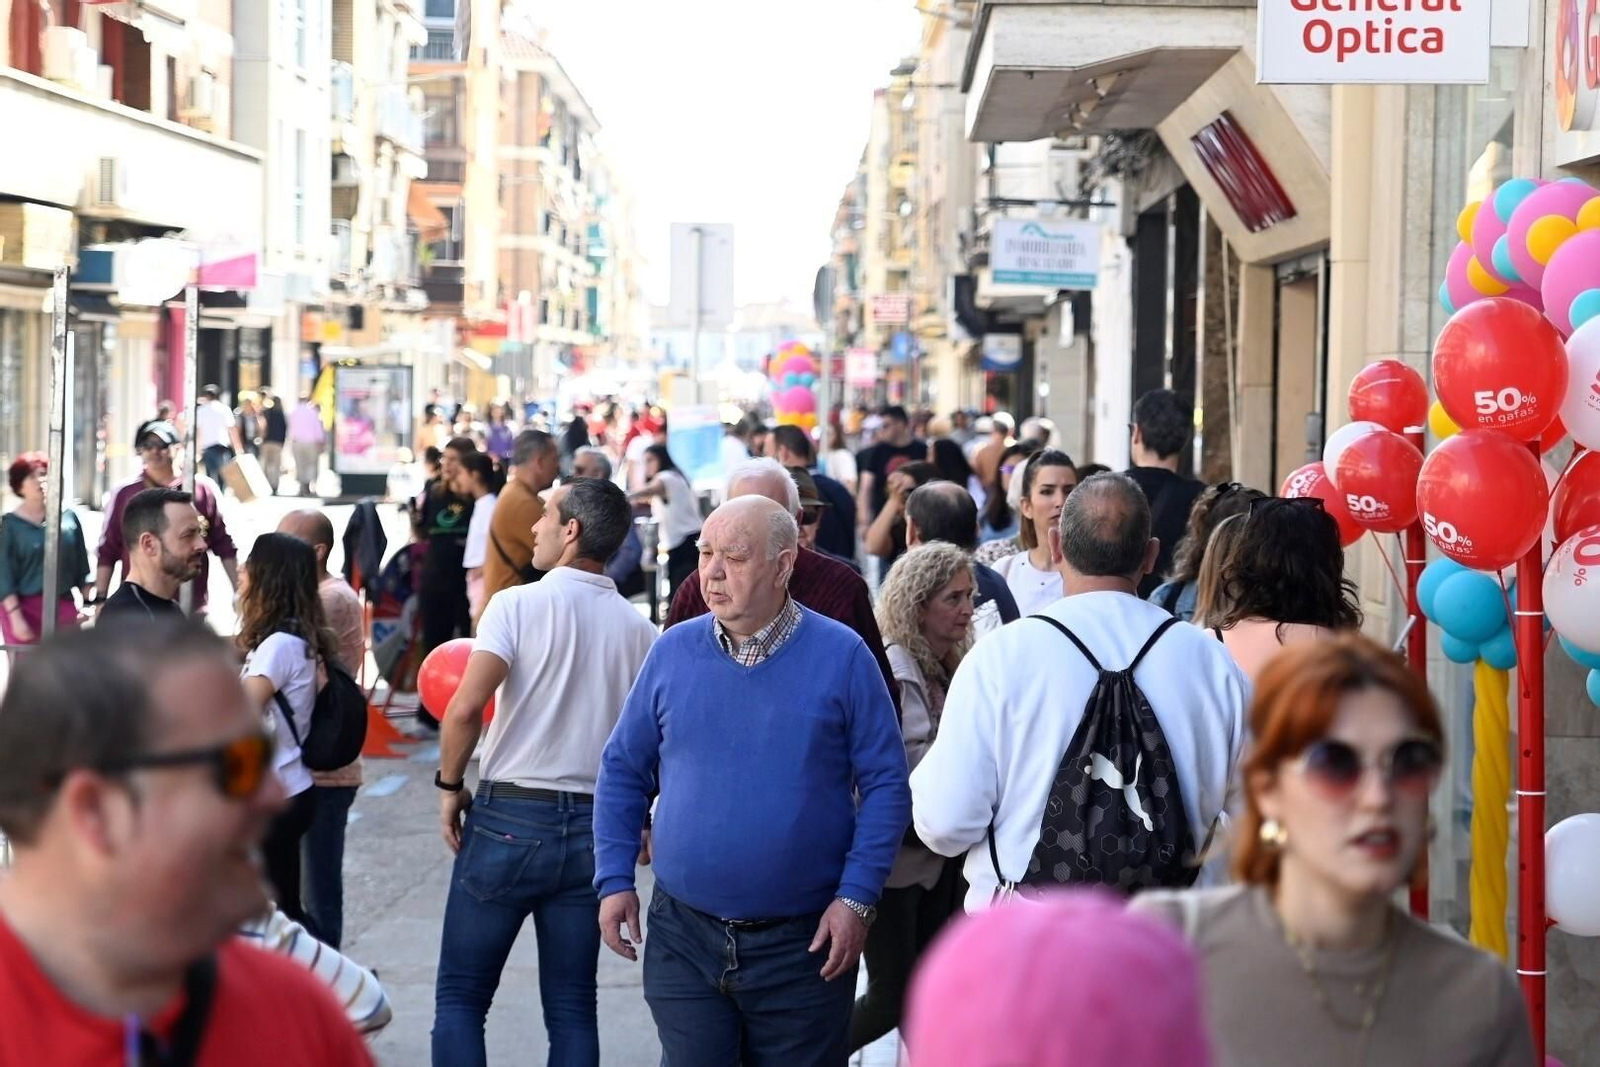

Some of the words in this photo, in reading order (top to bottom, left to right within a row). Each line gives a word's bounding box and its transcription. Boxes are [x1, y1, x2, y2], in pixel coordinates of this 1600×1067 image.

[1303, 17, 1443, 62] Optica
[1474, 387, 1536, 414] 50%
[1478, 415, 1494, 423] en
[1347, 494, 1389, 511] 50%
[1424, 512, 1472, 546] 50%
